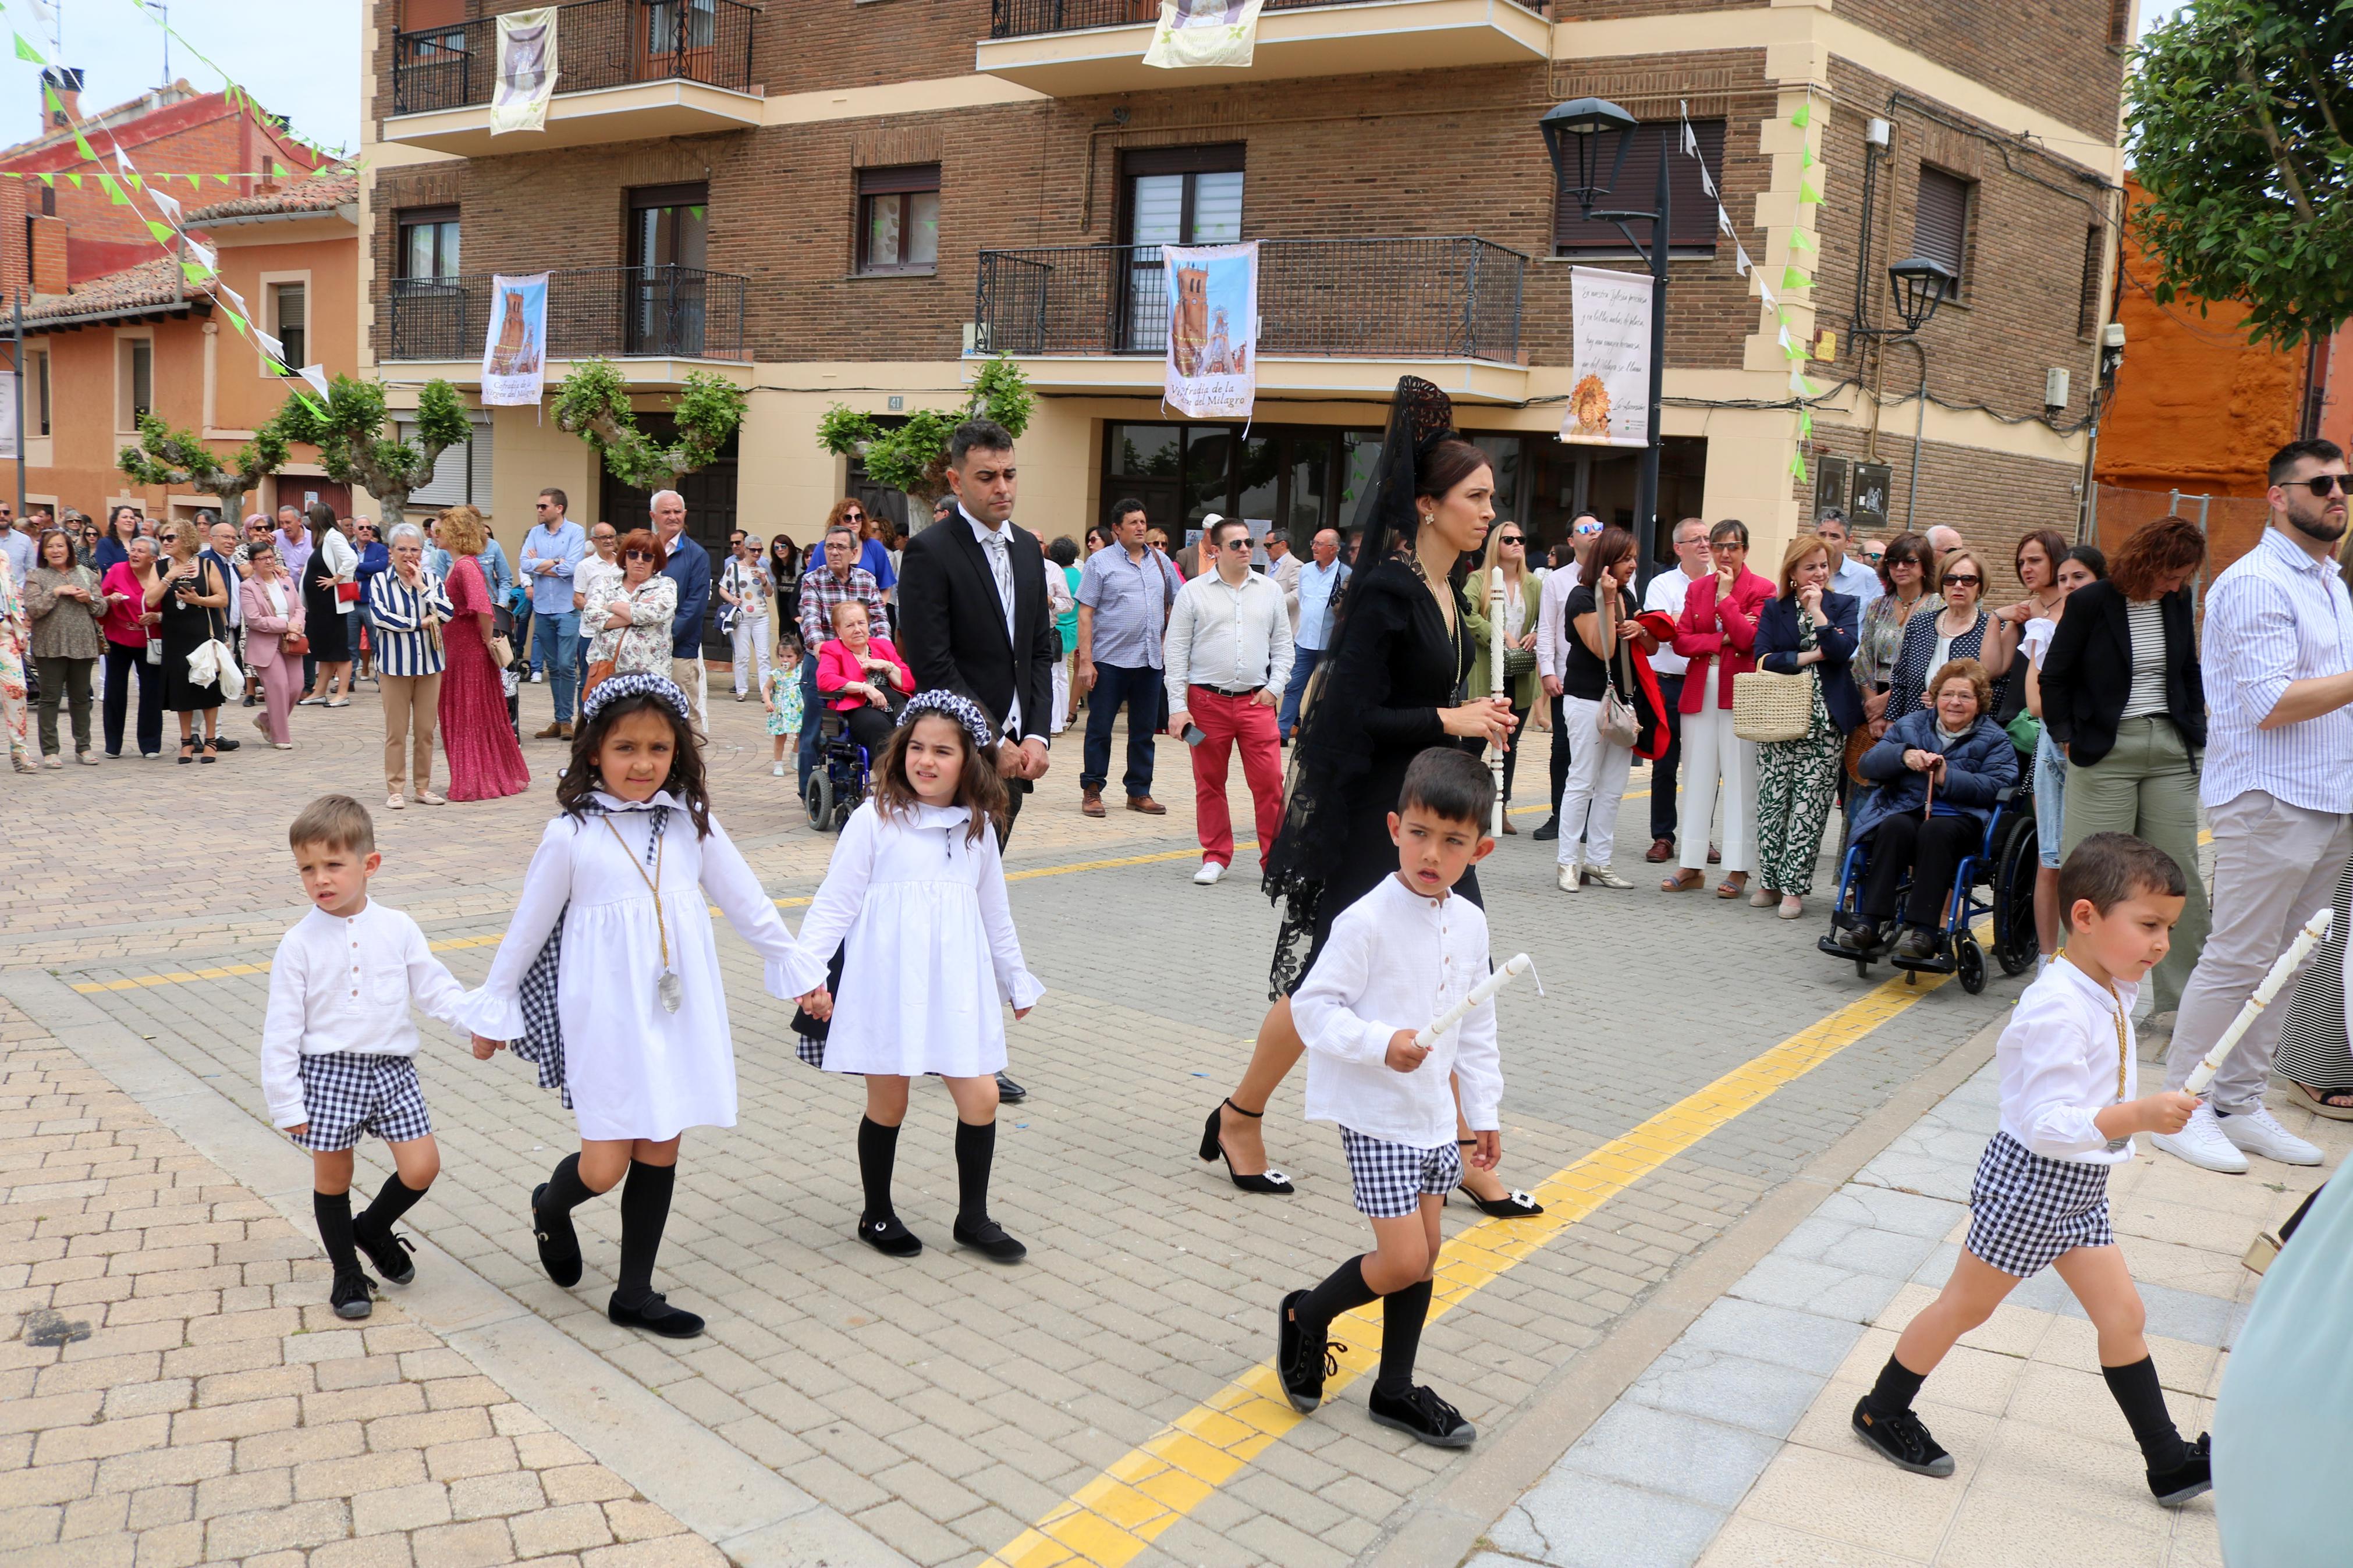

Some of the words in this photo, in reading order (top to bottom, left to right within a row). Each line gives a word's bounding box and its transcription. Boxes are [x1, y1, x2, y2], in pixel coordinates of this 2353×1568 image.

[486, 388, 506, 400] Virgen
[507, 389, 517, 397] del
[1179, 381, 1208, 396] ofradía
[1212, 382, 1223, 393] de
[1225, 381, 1234, 393] la
[890, 397, 900, 408] 41
[1194, 394, 1206, 406] del
[1208, 393, 1245, 408] Milagro
